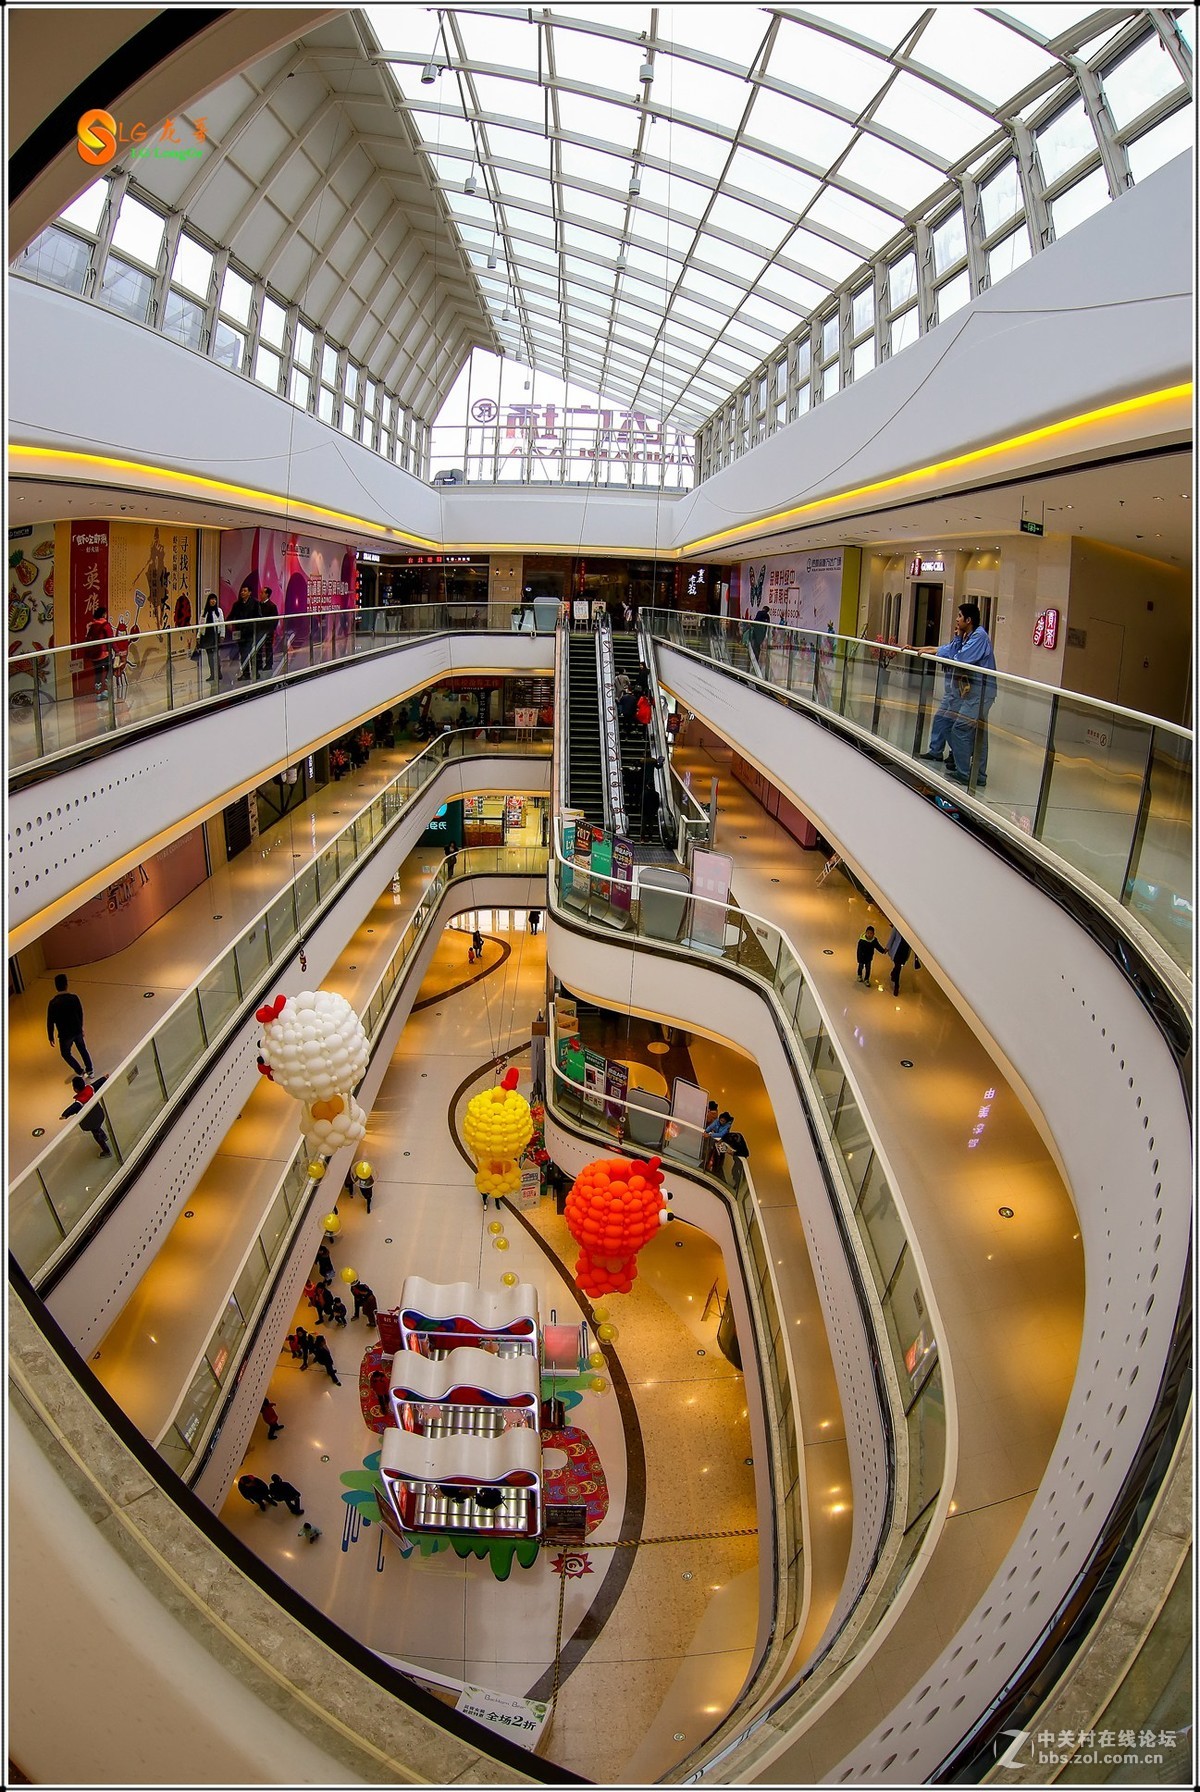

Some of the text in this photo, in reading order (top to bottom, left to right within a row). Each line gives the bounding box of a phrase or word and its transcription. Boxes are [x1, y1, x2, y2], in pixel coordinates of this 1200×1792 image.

[426, 821, 447, 830] 臣氏
[577, 827, 591, 841] 2017
[486, 1711, 536, 1732] 全场2折
